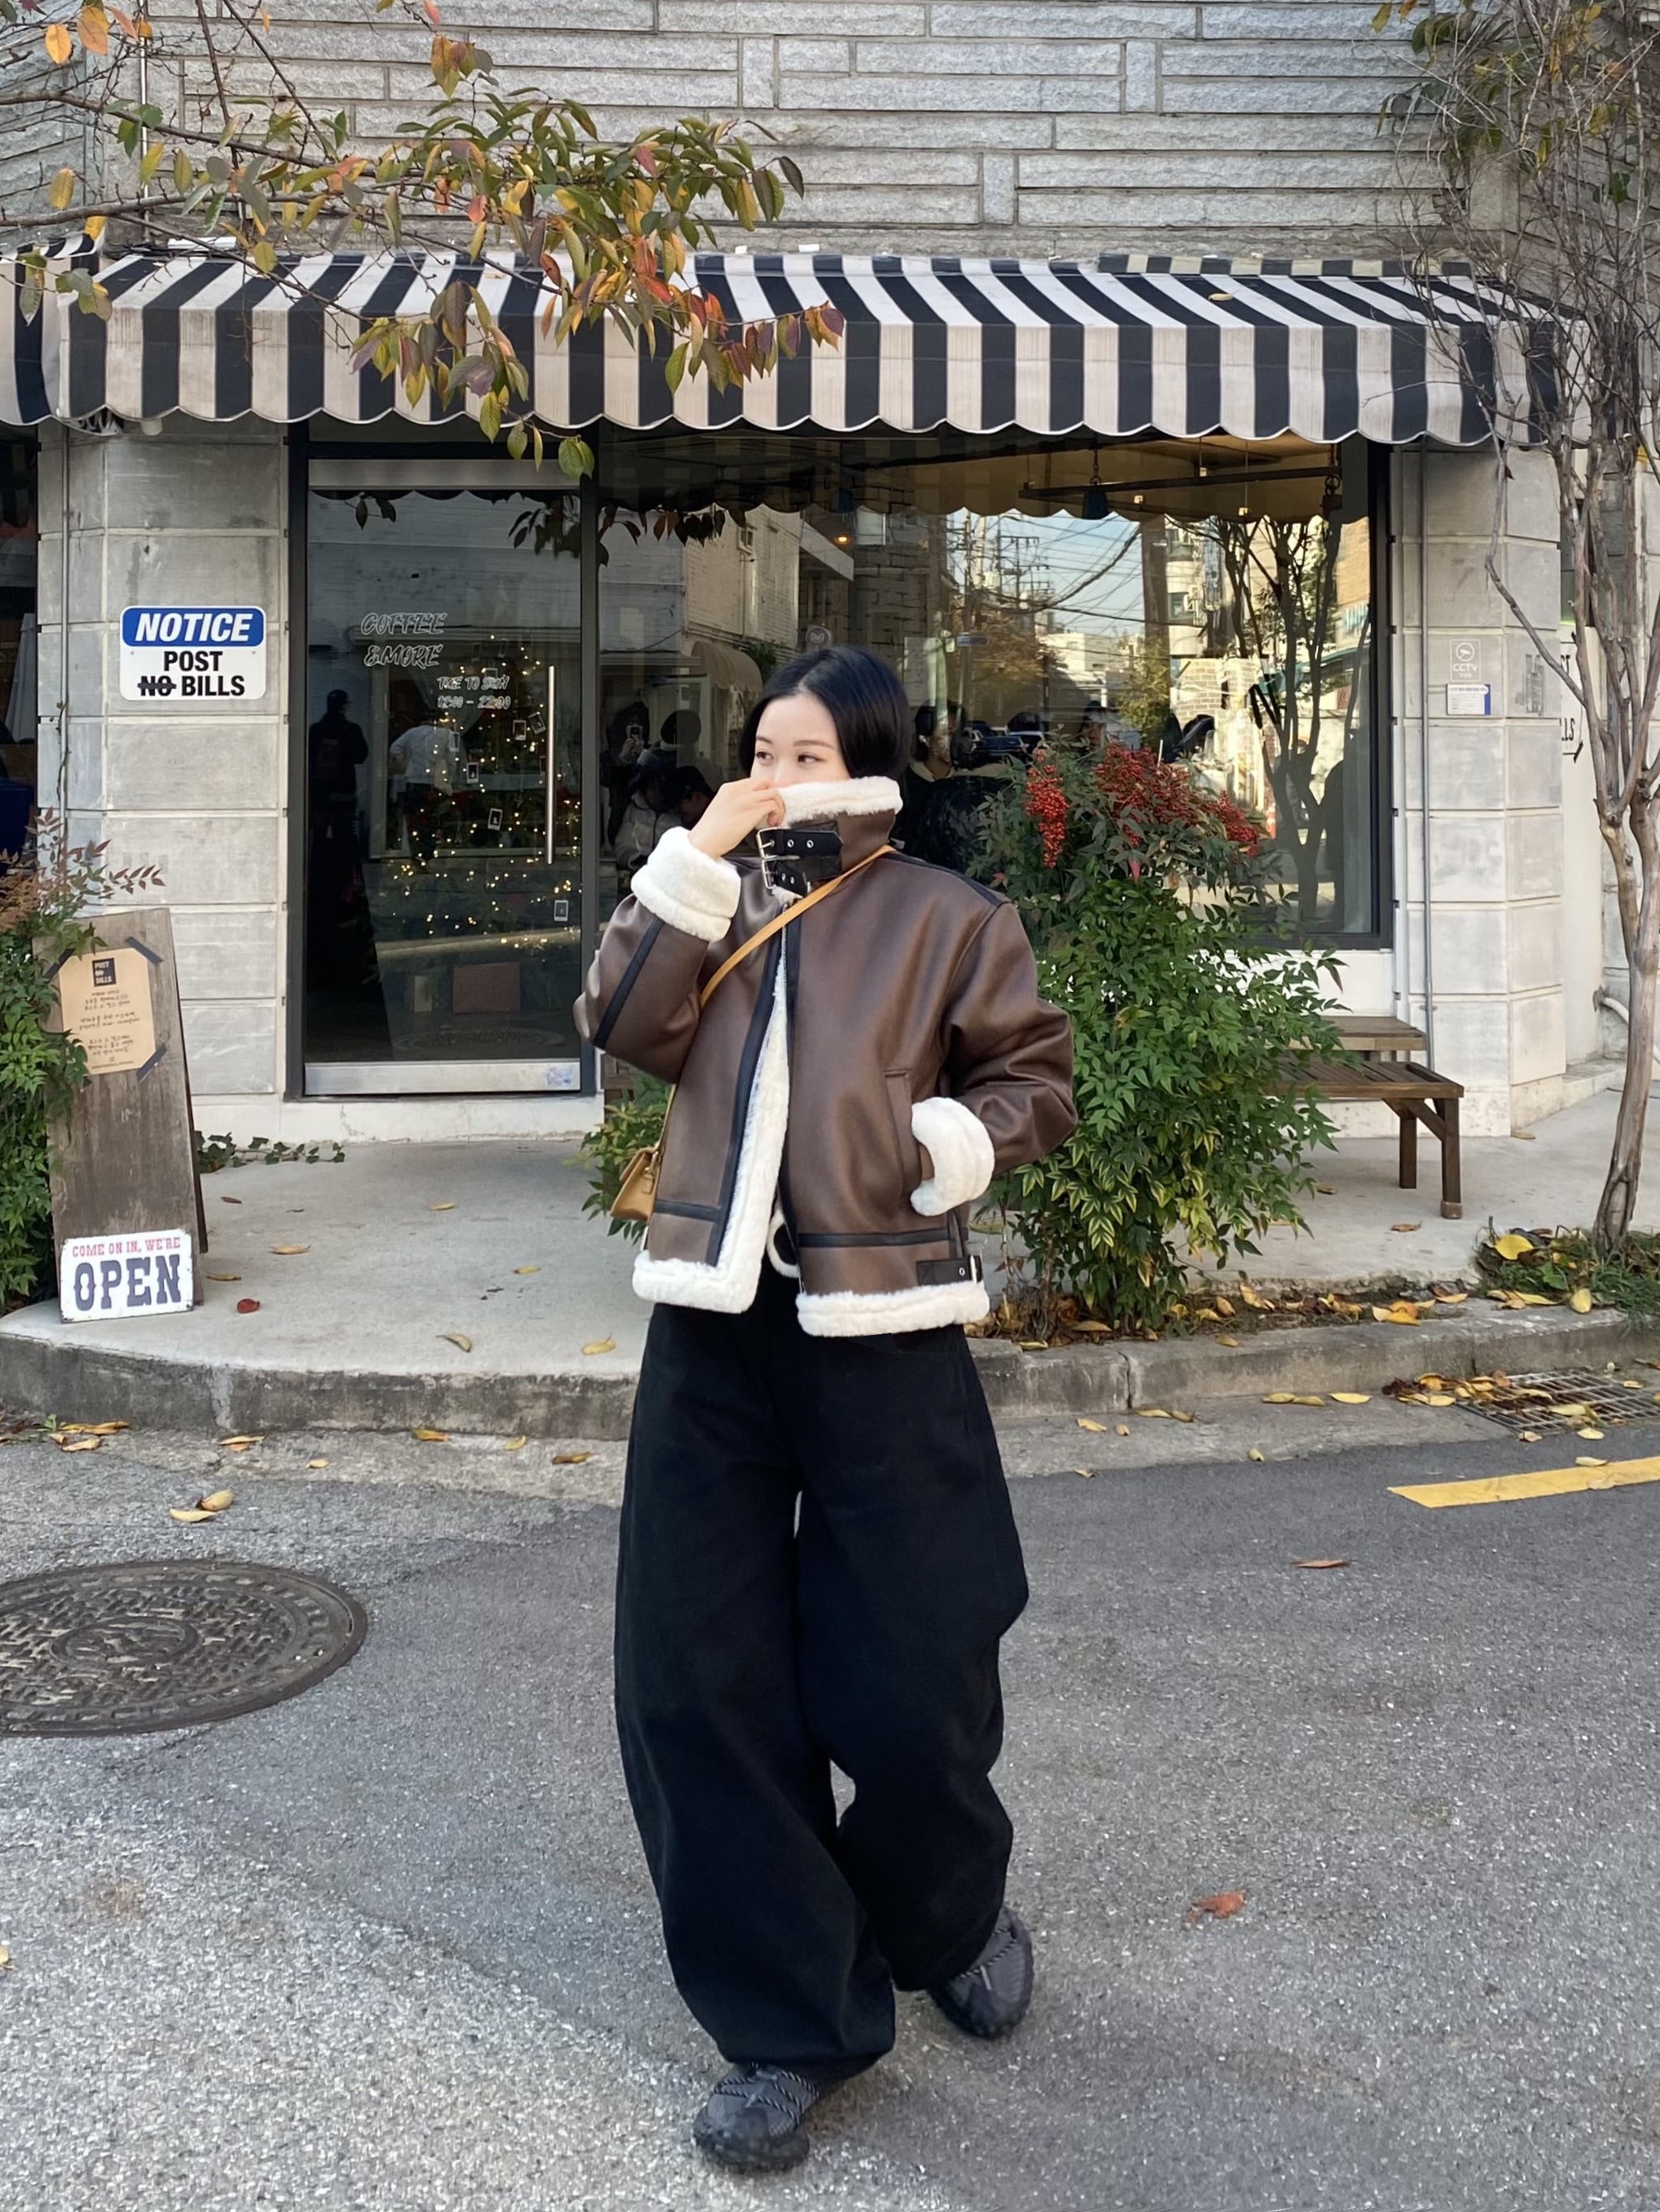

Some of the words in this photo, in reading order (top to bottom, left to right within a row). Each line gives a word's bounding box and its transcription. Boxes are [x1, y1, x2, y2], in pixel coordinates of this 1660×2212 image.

[135, 612, 253, 642] NOTICE
[361, 612, 447, 634] COFFEE
[163, 651, 223, 671] POST
[363, 644, 444, 670] &MORE
[1453, 663, 1478, 672] CCTV
[181, 675, 245, 697] BILLS
[465, 676, 480, 691] TO
[73, 1243, 105, 1257] COME
[109, 1241, 122, 1254] ON
[145, 1237, 180, 1251] WE'RE
[73, 1254, 181, 1311] OPEN
